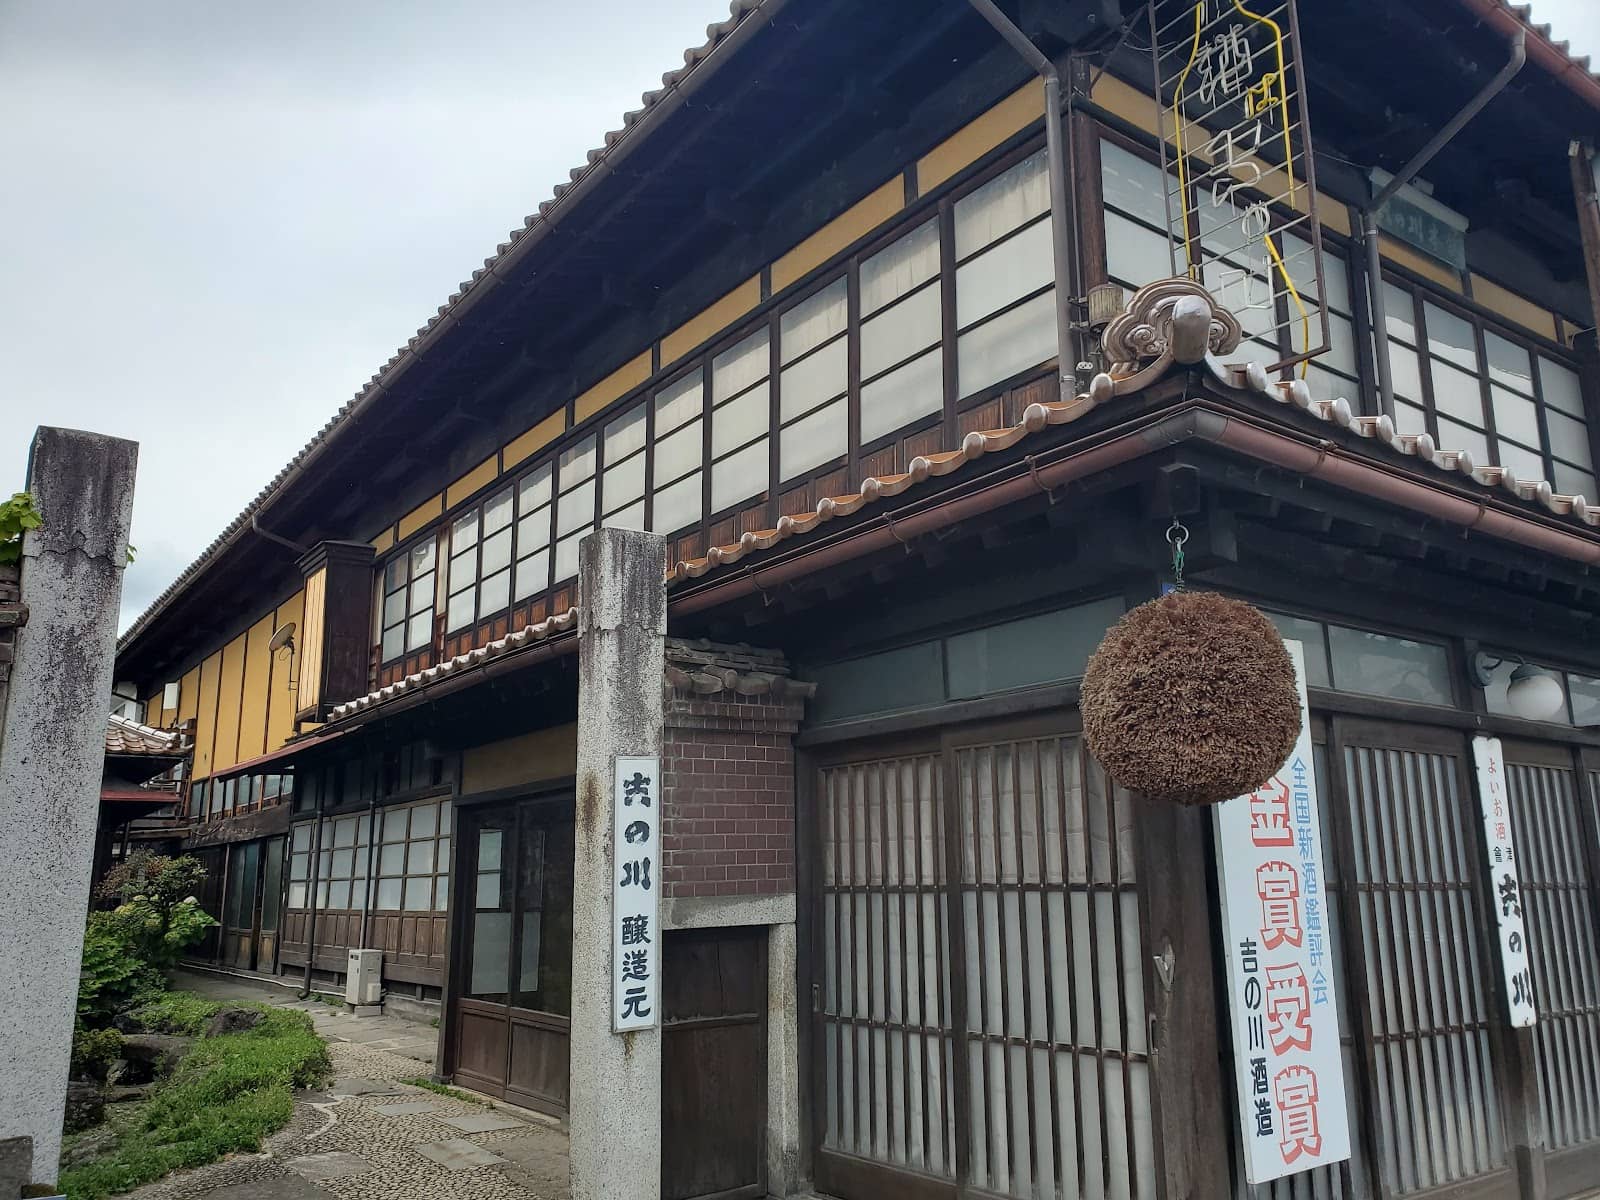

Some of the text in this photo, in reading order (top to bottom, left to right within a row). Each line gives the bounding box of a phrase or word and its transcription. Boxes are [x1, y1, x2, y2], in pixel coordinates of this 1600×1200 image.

[620, 772, 651, 890] 吉の川
[1291, 756, 1328, 1005] 全国新酒鑑評会
[1488, 758, 1505, 840] よいお酒
[1250, 775, 1322, 1165] 金賞受賞
[1498, 873, 1533, 1008] 吉の川
[1239, 937, 1274, 1138] 吉の川酒造
